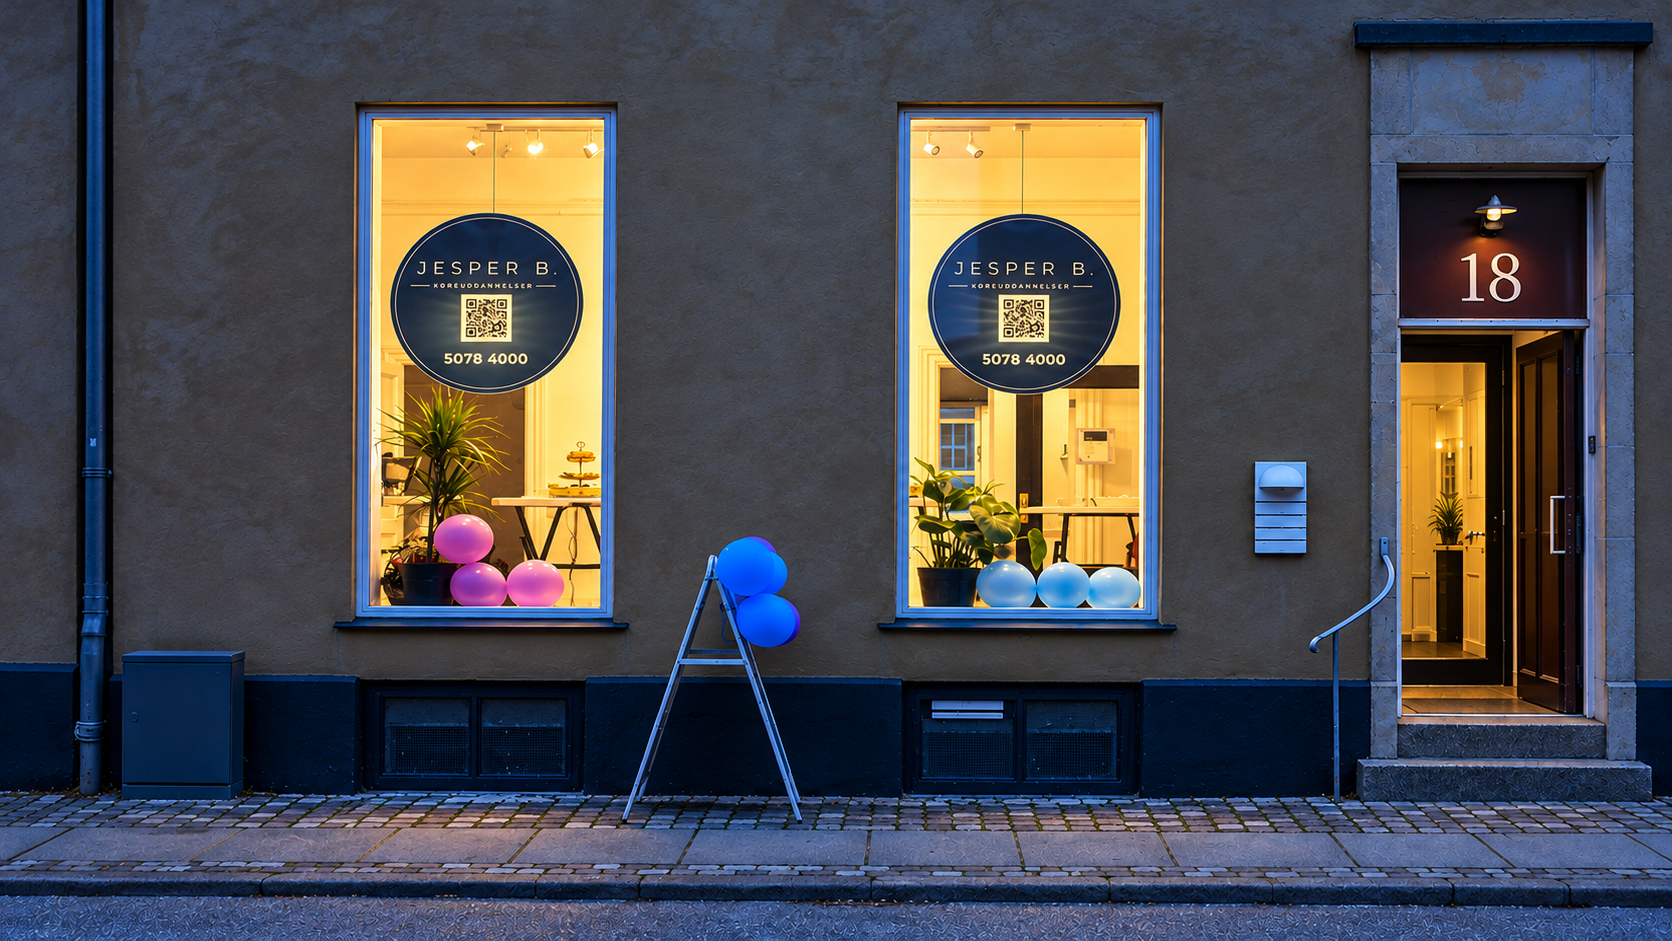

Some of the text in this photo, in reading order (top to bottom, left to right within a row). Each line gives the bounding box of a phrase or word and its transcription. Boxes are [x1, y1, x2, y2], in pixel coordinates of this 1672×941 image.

[417, 261, 557, 276] JESPER B.
[954, 261, 1094, 276] JESPER B.
[1460, 252, 1522, 303] 18
[443, 352, 529, 365] 5078 4000
[982, 353, 1066, 366] 5078 4000
